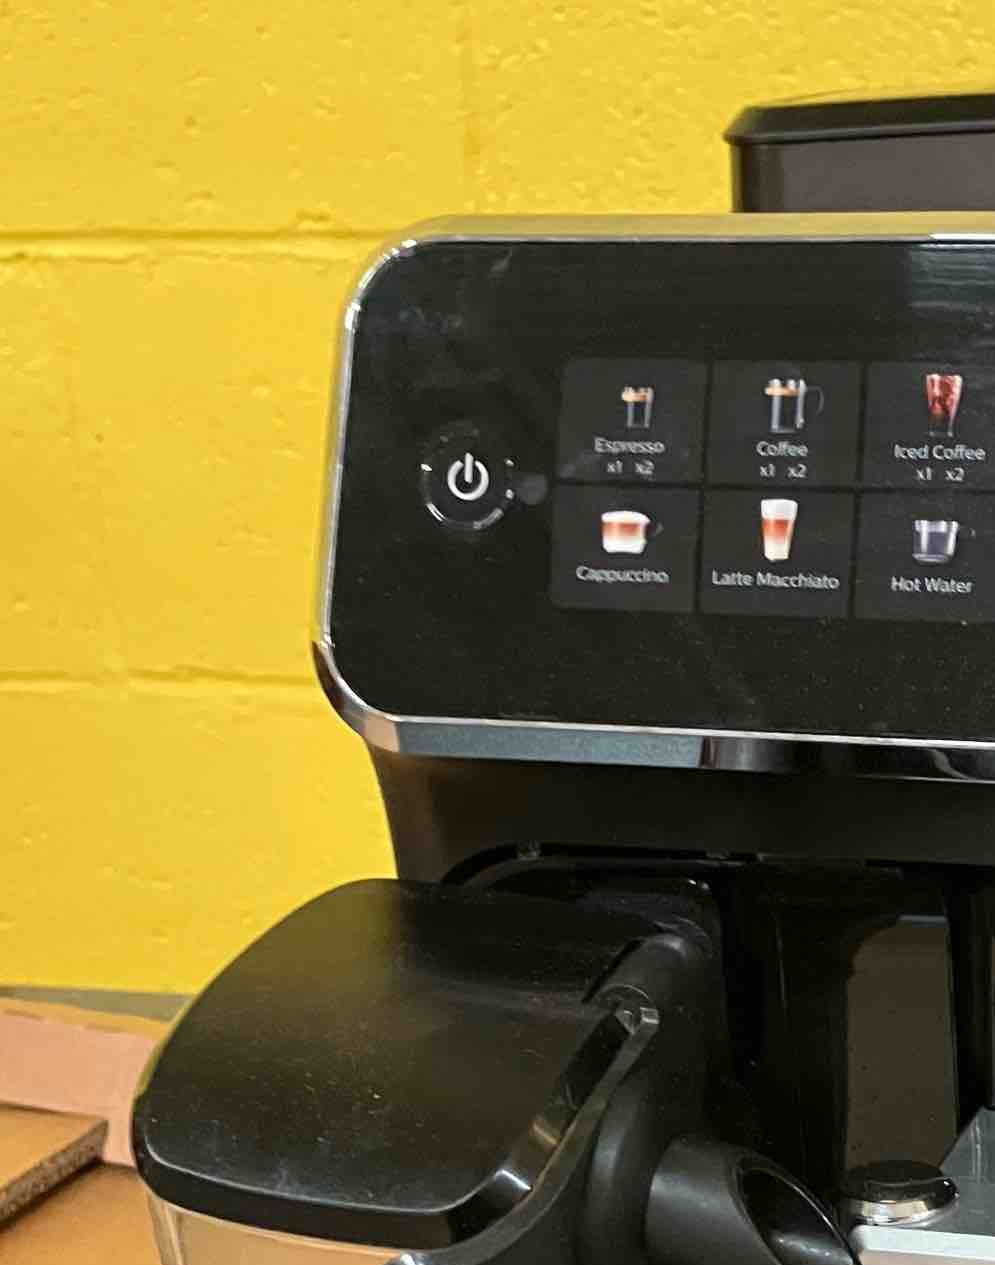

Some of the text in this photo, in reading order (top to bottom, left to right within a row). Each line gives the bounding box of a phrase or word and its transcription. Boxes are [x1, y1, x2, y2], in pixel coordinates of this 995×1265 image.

[594, 437, 665, 456] Espresso
[756, 441, 808, 458] Coffee
[894, 444, 986, 462] Iced Coffee
[607, 461, 655, 475] x1 x2
[759, 464, 808, 478] x1 x2
[916, 468, 964, 482] x1 x2
[576, 566, 669, 586] Cappuccino
[712, 570, 840, 590] Latte Macchiato
[891, 576, 974, 594] Hot Water
